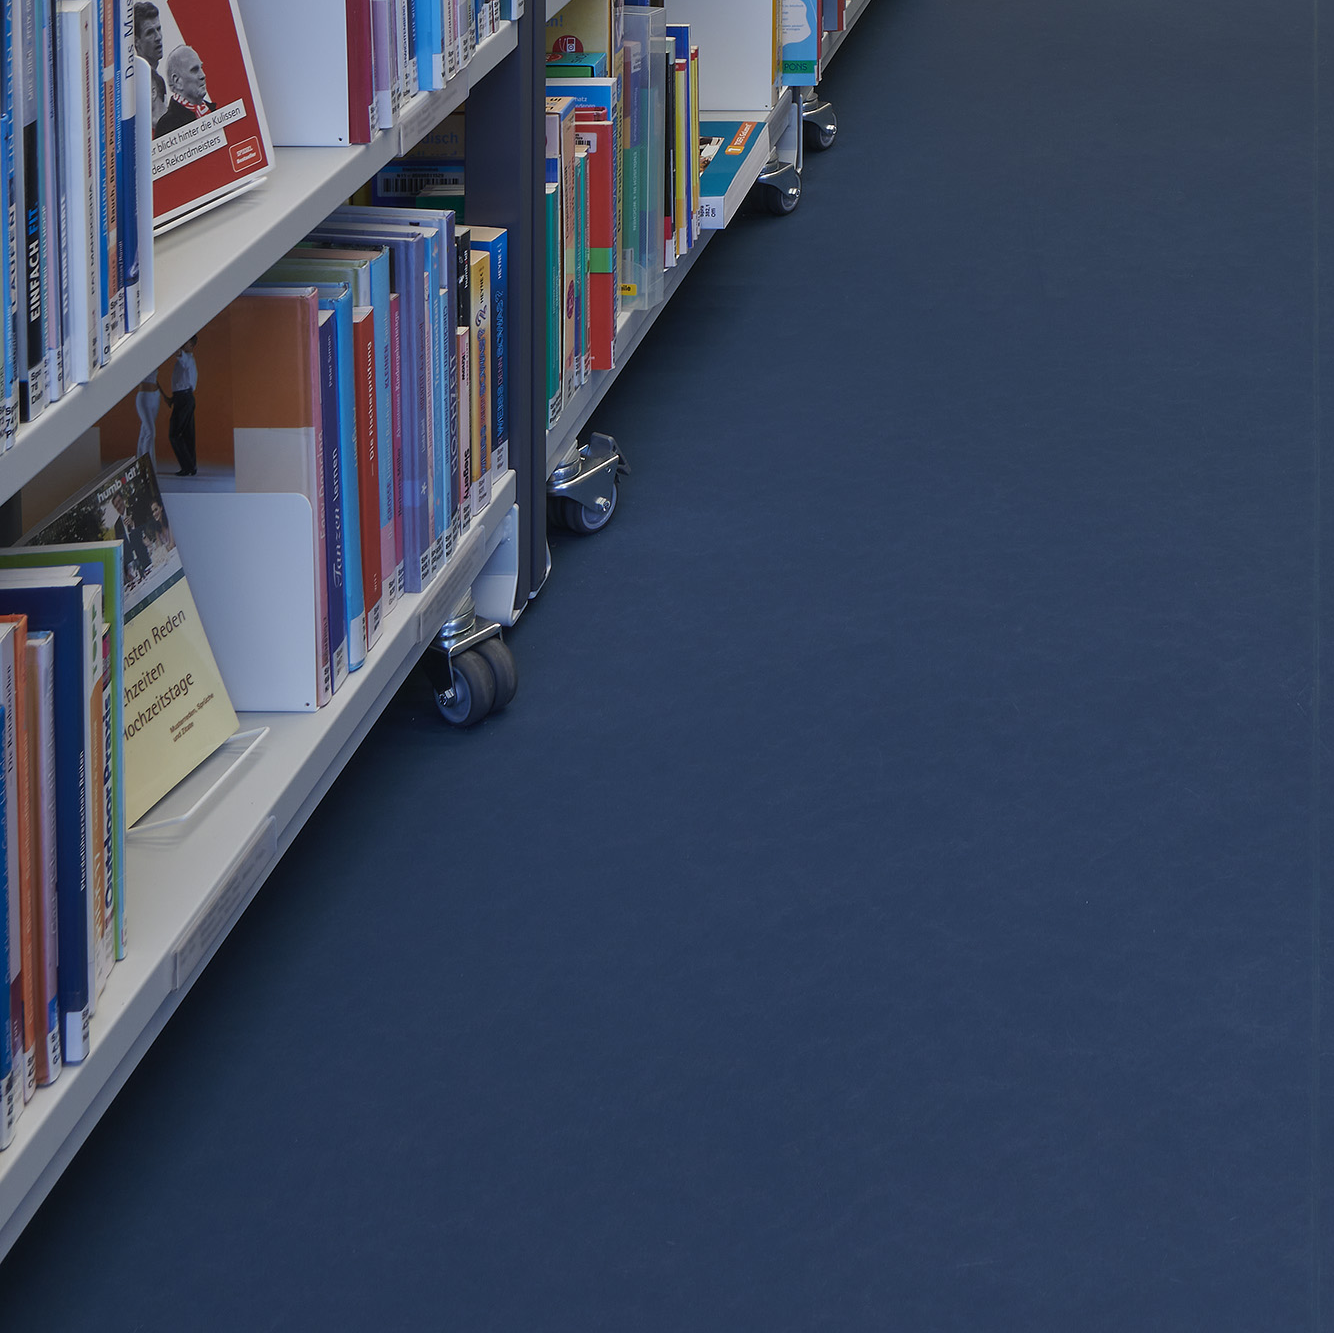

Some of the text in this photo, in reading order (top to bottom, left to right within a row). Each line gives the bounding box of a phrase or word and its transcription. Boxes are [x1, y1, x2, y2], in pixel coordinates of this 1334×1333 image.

[783, 62, 807, 72] PONS
[213, 104, 241, 129] Kulissen
[165, 137, 221, 167] Rekordmeisters
[30, 238, 41, 323] EINFACH
[152, 607, 187, 642] Reden
